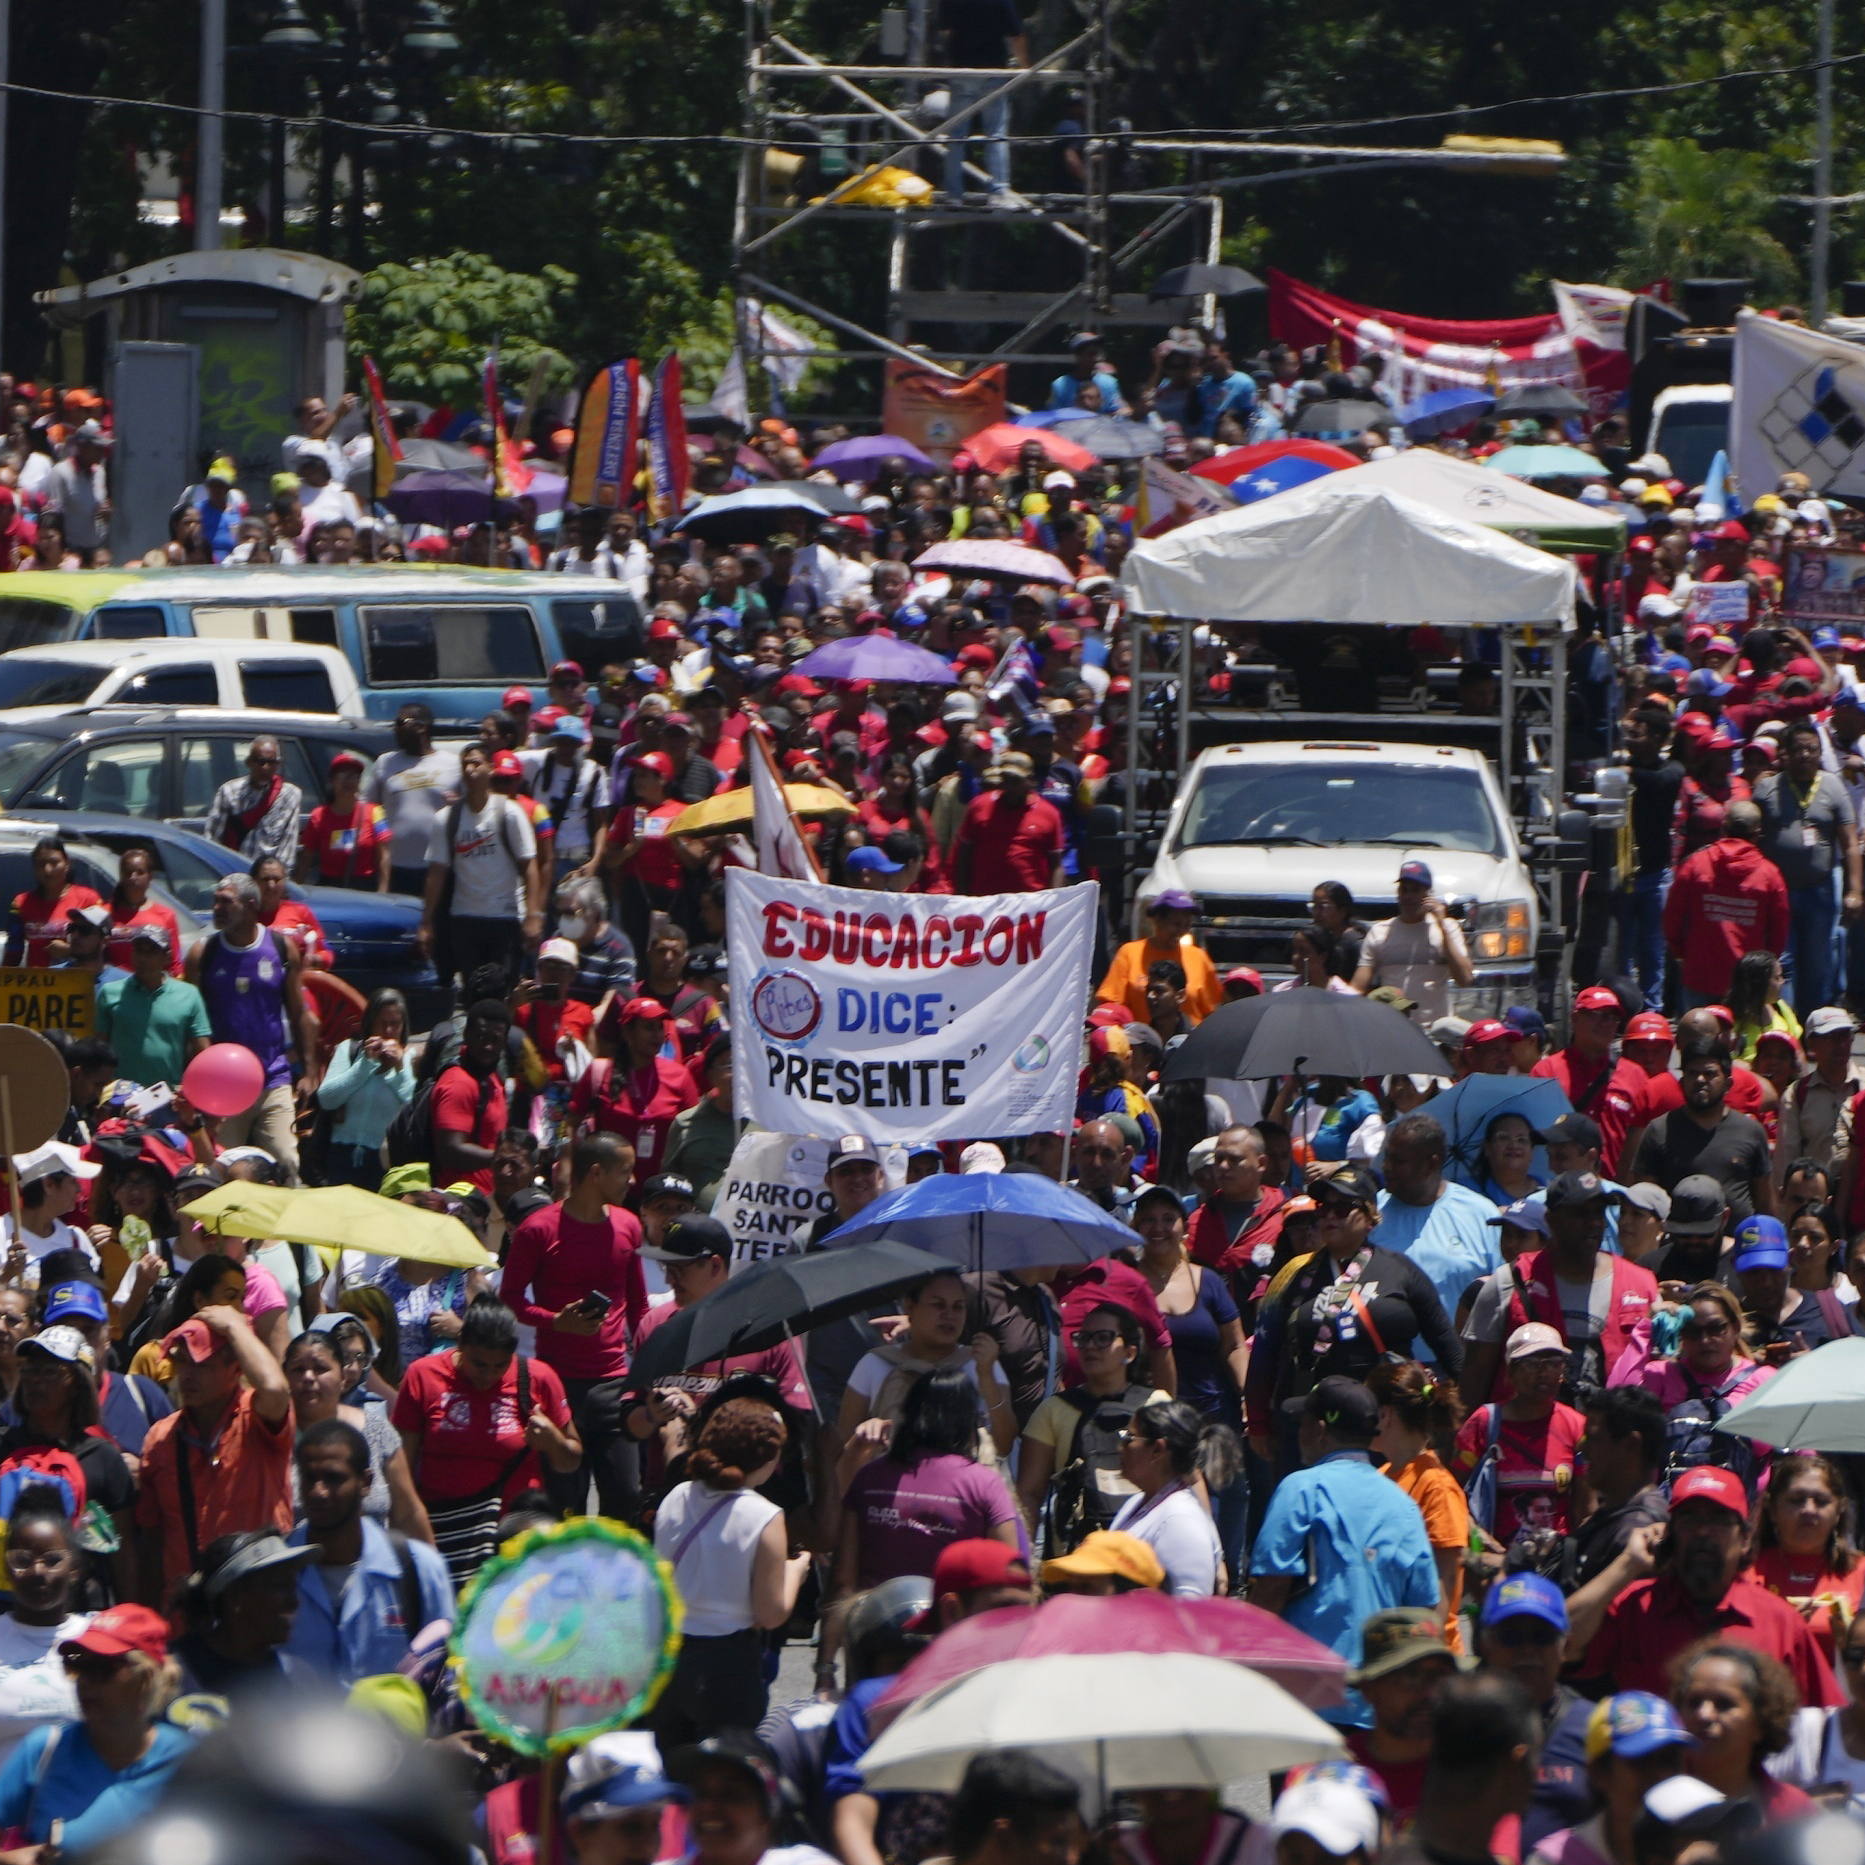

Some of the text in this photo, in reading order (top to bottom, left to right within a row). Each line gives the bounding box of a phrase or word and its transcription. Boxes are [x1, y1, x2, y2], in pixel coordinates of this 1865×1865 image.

[761, 901, 1047, 969] EDUCACION
[9, 995, 85, 1029] PARE
[837, 988, 956, 1035] DICE:
[484, 1674, 630, 1704] ARAGUA
